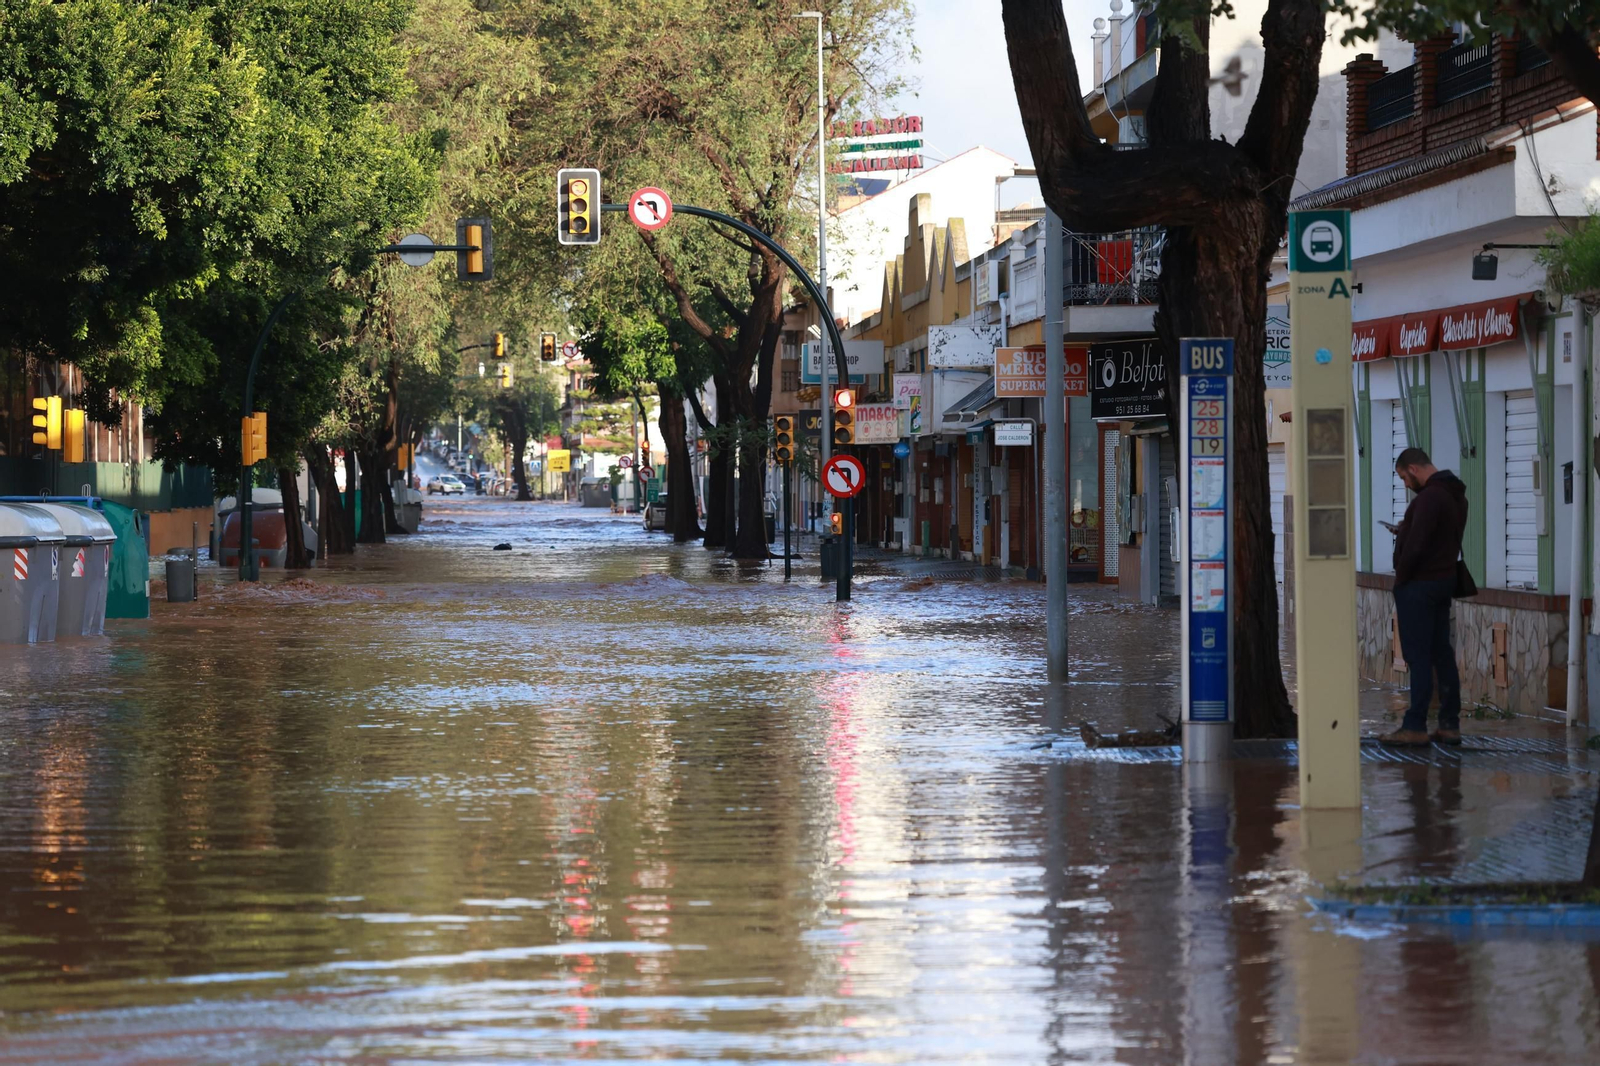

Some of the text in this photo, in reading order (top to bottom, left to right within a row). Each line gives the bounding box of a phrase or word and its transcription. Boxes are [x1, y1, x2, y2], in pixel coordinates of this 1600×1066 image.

[1297, 277, 1350, 299] ZONA A
[1191, 346, 1224, 369] BUS
[999, 363, 1082, 376] MERCDO
[1119, 343, 1166, 392] Belfot
[1000, 379, 1085, 391] SUPERMKET
[1115, 405, 1125, 414] 951
[1127, 405, 1134, 414] 25
[1196, 401, 1220, 416] 25
[1196, 420, 1219, 435] 28
[1198, 439, 1220, 453] 19
